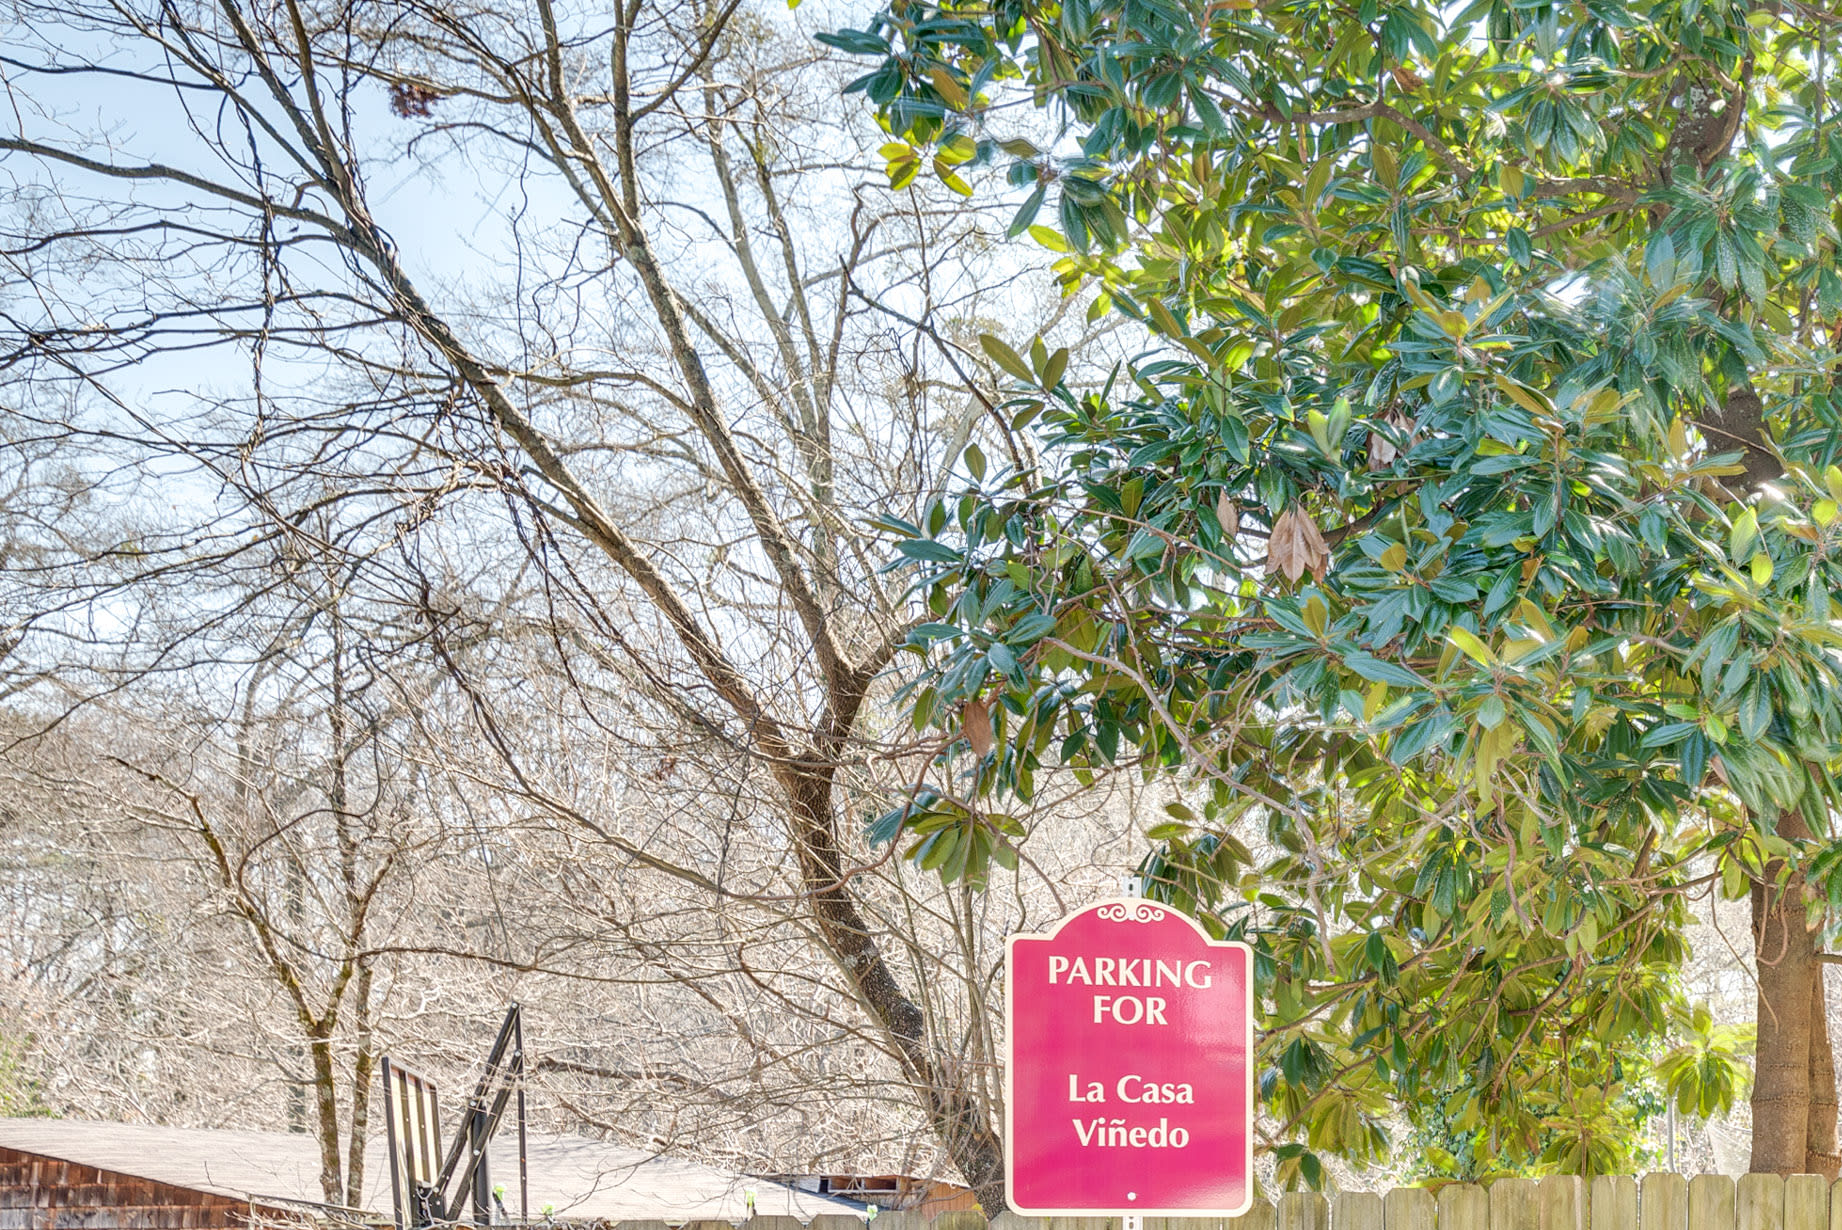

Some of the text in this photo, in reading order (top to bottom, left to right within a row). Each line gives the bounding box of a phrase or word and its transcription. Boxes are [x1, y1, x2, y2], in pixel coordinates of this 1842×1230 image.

[1049, 956, 1212, 989] PARKING
[1094, 995, 1168, 1025] FOR
[1069, 1074, 1194, 1104] La Casa
[1073, 1118, 1189, 1148] Viñedo
